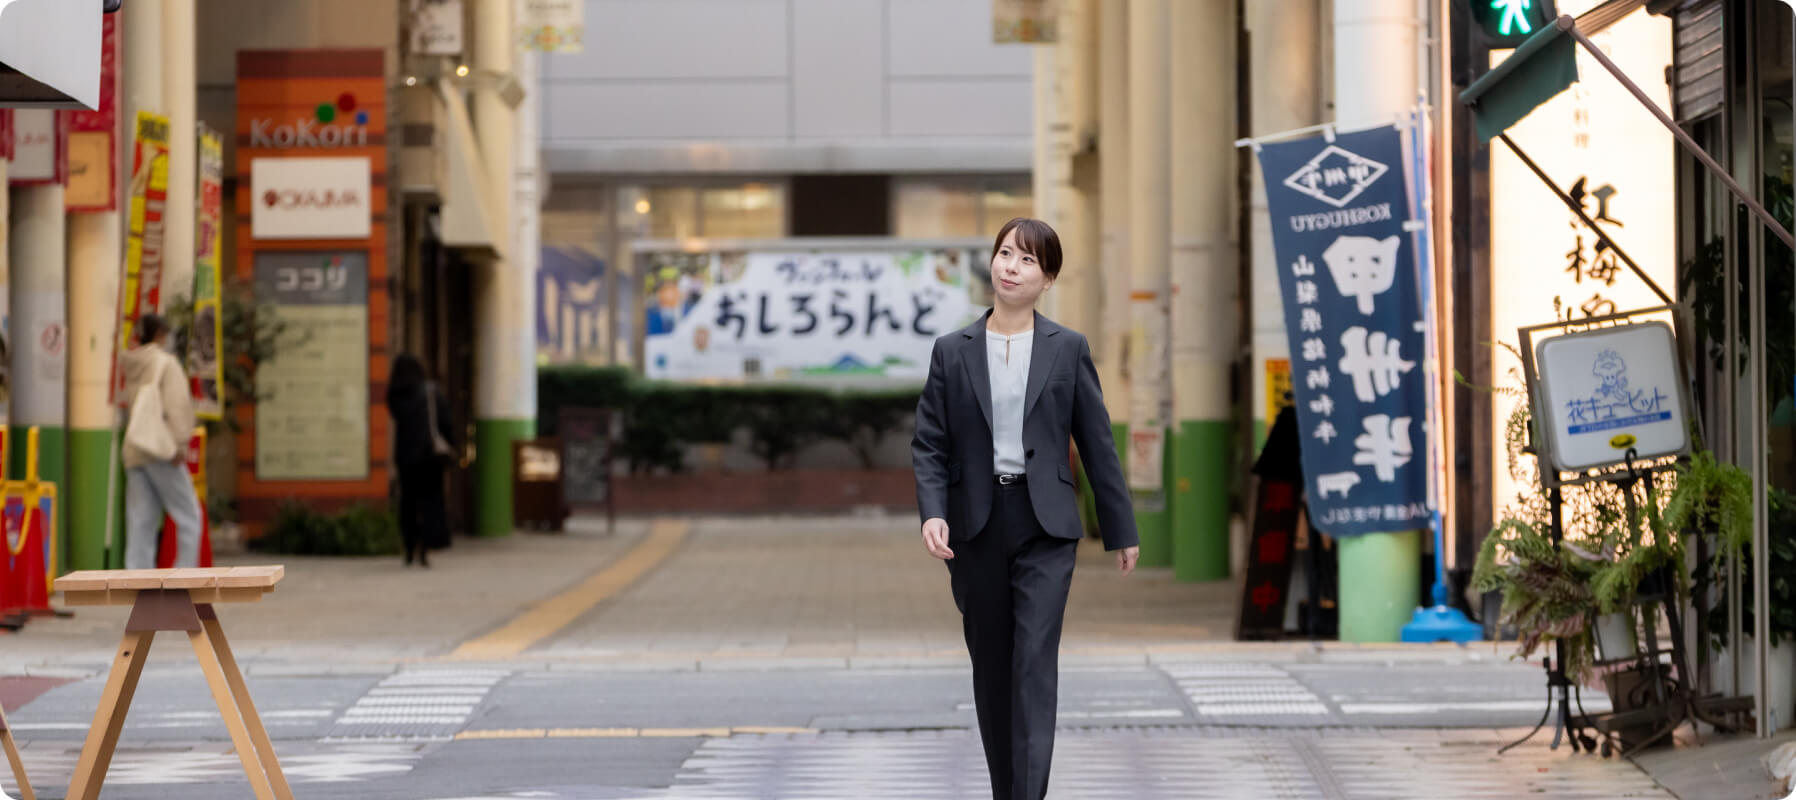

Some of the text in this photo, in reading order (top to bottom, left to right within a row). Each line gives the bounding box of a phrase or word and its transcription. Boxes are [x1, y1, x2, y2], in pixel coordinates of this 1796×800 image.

[250, 116, 368, 149] KoKori
[275, 266, 348, 293] ココリ
[714, 289, 946, 340] おしろらんど
